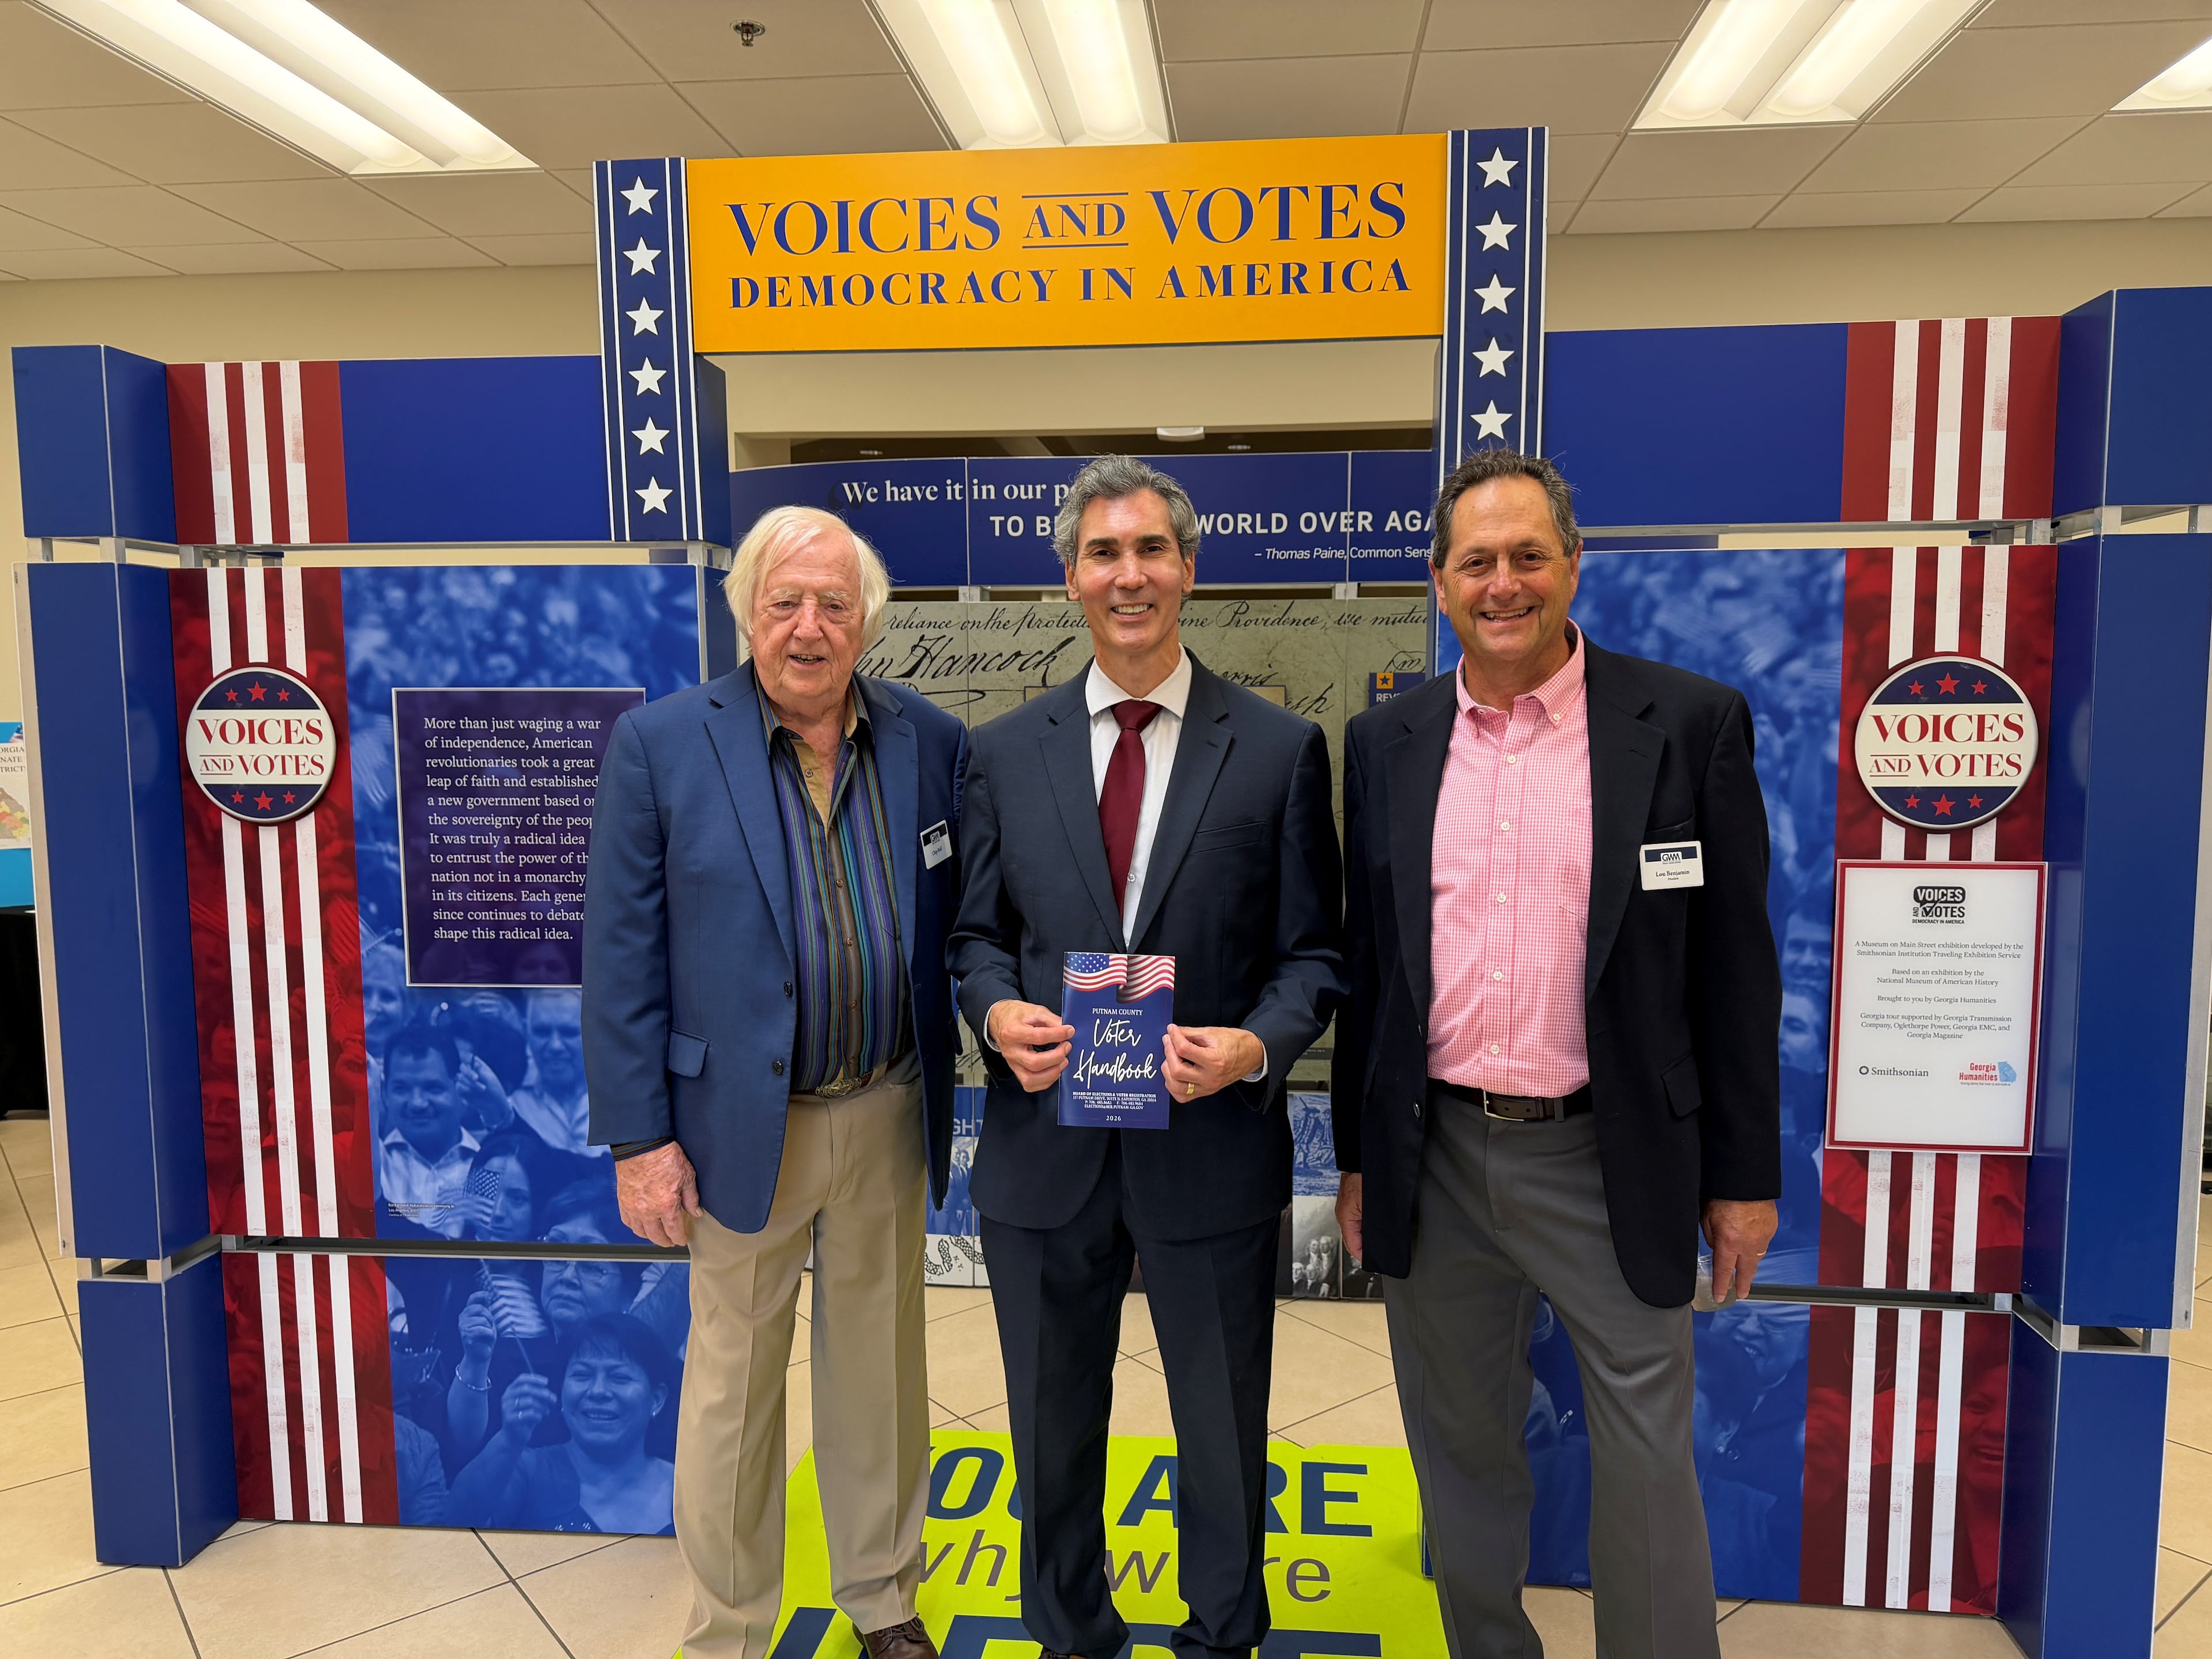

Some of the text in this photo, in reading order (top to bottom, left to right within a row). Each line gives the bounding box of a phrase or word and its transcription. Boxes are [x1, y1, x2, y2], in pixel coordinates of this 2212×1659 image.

[724, 182, 1405, 256] VOICES AND VOTES
[728, 258, 1412, 308] DEMOCRACY IN AMERICA
[842, 479, 1047, 503] We have it in our
[990, 510, 1373, 536] TO WORLD OVER
[1266, 546, 1431, 559] Thomas Paine, Common Sens
[898, 634, 1076, 687] Hancock
[196, 719, 323, 744] VOICES
[424, 717, 601, 733] More than just waging a war
[1871, 713, 2024, 743] VOICES
[425, 736, 593, 752] of independence, American
[200, 755, 324, 775] AND VOTES
[426, 756, 595, 771] revolutionaries took a great
[1869, 753, 2021, 777] AND VOTES
[426, 775, 599, 790] leap of faith and established
[427, 794, 579, 809] a new government based
[429, 813, 562, 829] the sovereignty of the
[430, 832, 585, 848] It was truly a radical idea
[430, 851, 574, 867] to entrust the power of
[431, 871, 586, 887] nation not in a monarchy
[432, 889, 551, 902] in its citizens. Each
[1916, 888, 1963, 902] VOICES
[433, 908, 543, 921] since continues to
[1921, 906, 1965, 918] VOTES
[434, 927, 573, 942] shape this radical idea.
[1971, 942, 2002, 950] developed
[2004, 943, 2012, 951] by
[1933, 951, 1962, 959] Traveling
[1964, 969, 1972, 978] by
[1975, 979, 1999, 987] History
[1925, 996, 1933, 1004] by
[1934, 1014, 1942, 1022] by
[1943, 1014, 1968, 1022] Georgia
[1094, 1018, 1142, 1047] Voter
[1861, 1022, 1892, 1030] Company,
[1893, 1022, 1929, 1031] Oglethorpe
[1953, 1024, 1977, 1032] Georgia
[1907, 1032, 1931, 1040] Georgia
[1073, 1049, 1157, 1089] Handbook
[1872, 1067, 1929, 1077] Smithsonian
[1969, 1062, 1996, 1073] Georgia
[1959, 1072, 1998, 1081] Humanities
